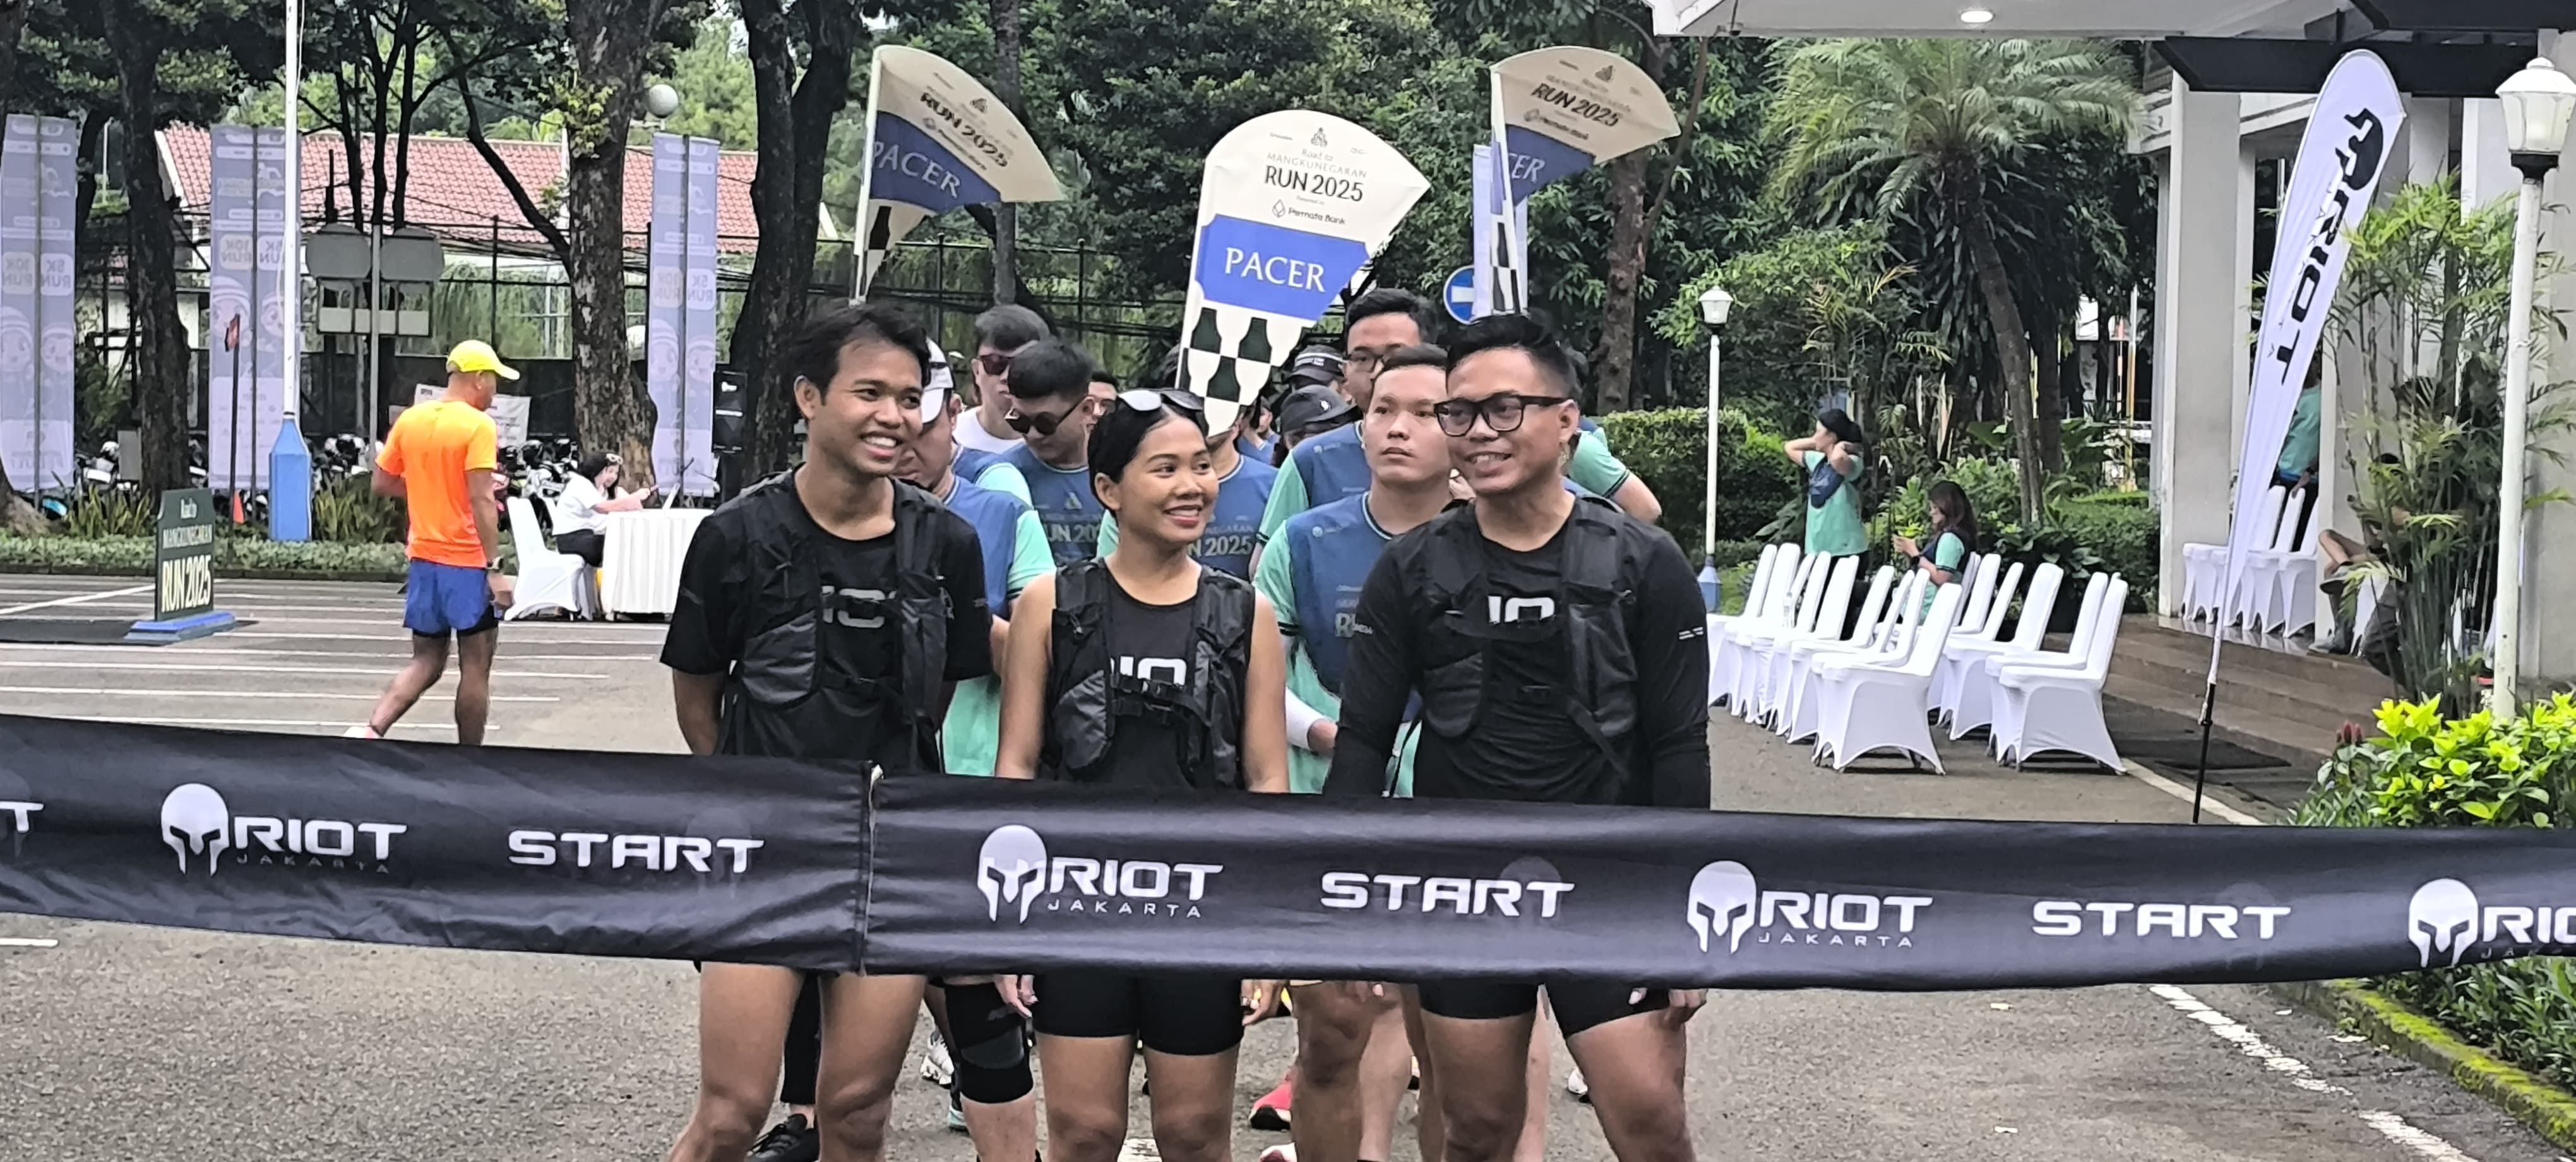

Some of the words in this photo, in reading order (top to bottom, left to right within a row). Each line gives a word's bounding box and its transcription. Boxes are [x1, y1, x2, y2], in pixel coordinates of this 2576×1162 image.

[1530, 83, 1577, 108] RUN
[1570, 99, 1621, 127] 2025
[921, 92, 962, 128] RUN
[961, 125, 1008, 167] 2025
[874, 141, 960, 199] PACER
[1265, 165, 1308, 191] RUN
[1310, 174, 1364, 201] 2025
[1267, 152, 1366, 177] MANGKUNEGARAN
[1225, 247, 1326, 292] PACER
[2277, 189, 2349, 385] RIOT
[1044, 524, 1071, 542] UN
[1205, 535, 1253, 556] 2025
[162, 558, 186, 613] RUN
[186, 555, 212, 609] 2025
[234, 817, 407, 860] RIOT
[508, 830, 765, 873] START
[237, 853, 389, 874] JAKARTA
[1049, 857, 1223, 901] RIOT
[1048, 899, 1201, 919] JAKARTA
[1320, 872, 1575, 918] START
[1760, 890, 1933, 933] RIOT
[1758, 932, 1912, 948] JAKARTA
[2033, 901, 2291, 939] START
